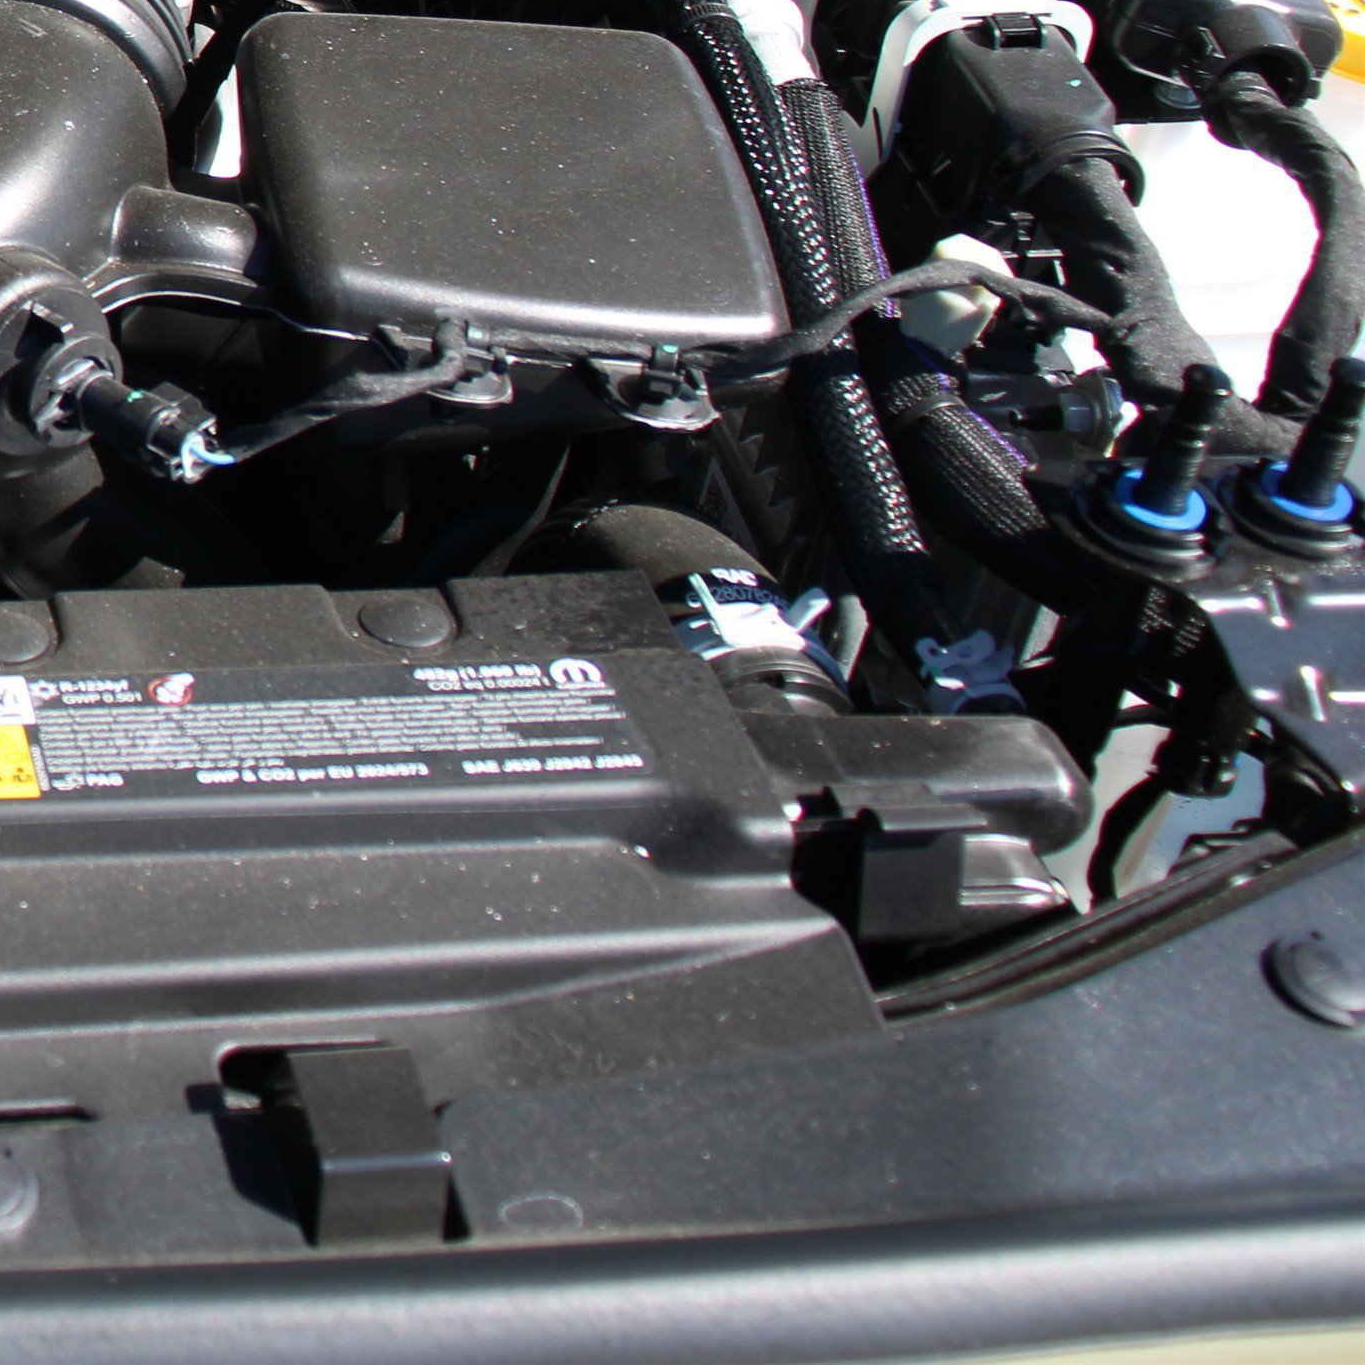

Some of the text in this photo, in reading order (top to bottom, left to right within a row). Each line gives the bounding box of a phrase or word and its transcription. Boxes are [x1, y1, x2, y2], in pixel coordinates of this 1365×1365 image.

[427, 680, 462, 691] CO2
[61, 692, 101, 704] GWP
[462, 758, 501, 774] SAE
[85, 772, 124, 787] PAG
[196, 768, 240, 784] GWP
[257, 766, 296, 782] CO2
[297, 767, 326, 783] per
[326, 764, 355, 779] EU
